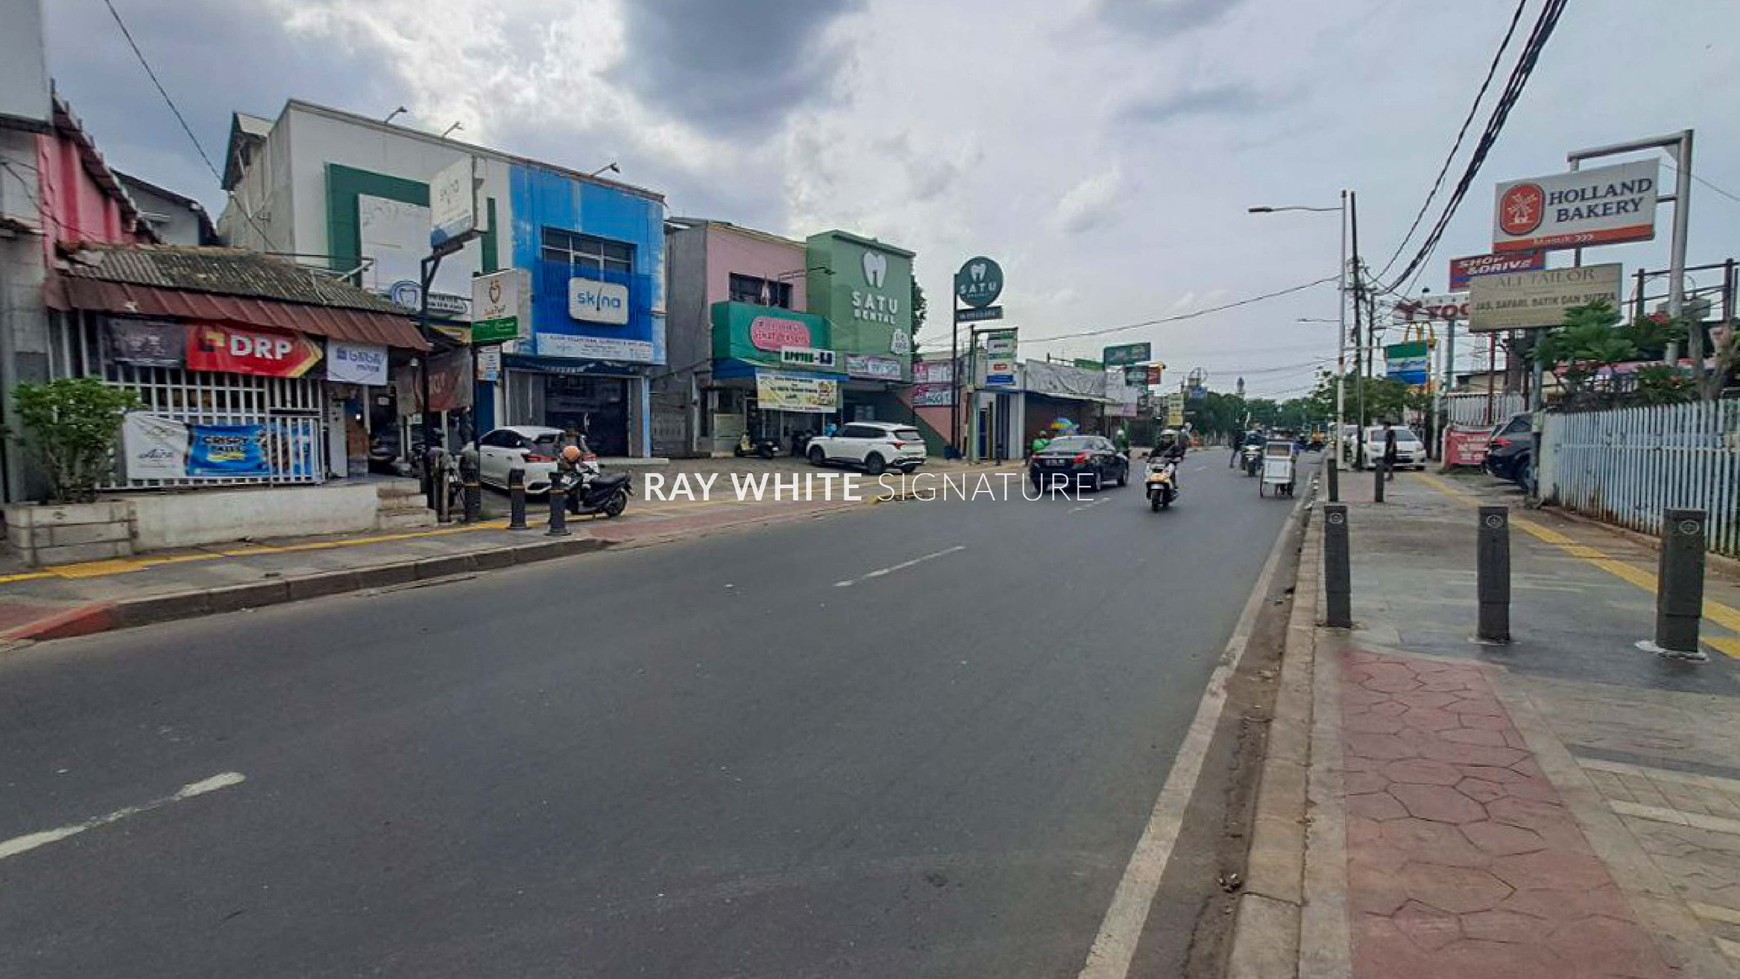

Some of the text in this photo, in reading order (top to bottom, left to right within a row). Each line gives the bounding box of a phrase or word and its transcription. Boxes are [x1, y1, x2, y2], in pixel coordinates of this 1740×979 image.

[1549, 178, 1653, 206] HOLLAND
[1556, 198, 1645, 223] BAKERY
[960, 281, 997, 294] SATU
[1531, 268, 1594, 284] TAILOR
[577, 287, 622, 312] skina
[852, 291, 898, 314] SATU
[854, 309, 896, 324] DENTAL
[230, 334, 293, 360] DRP
